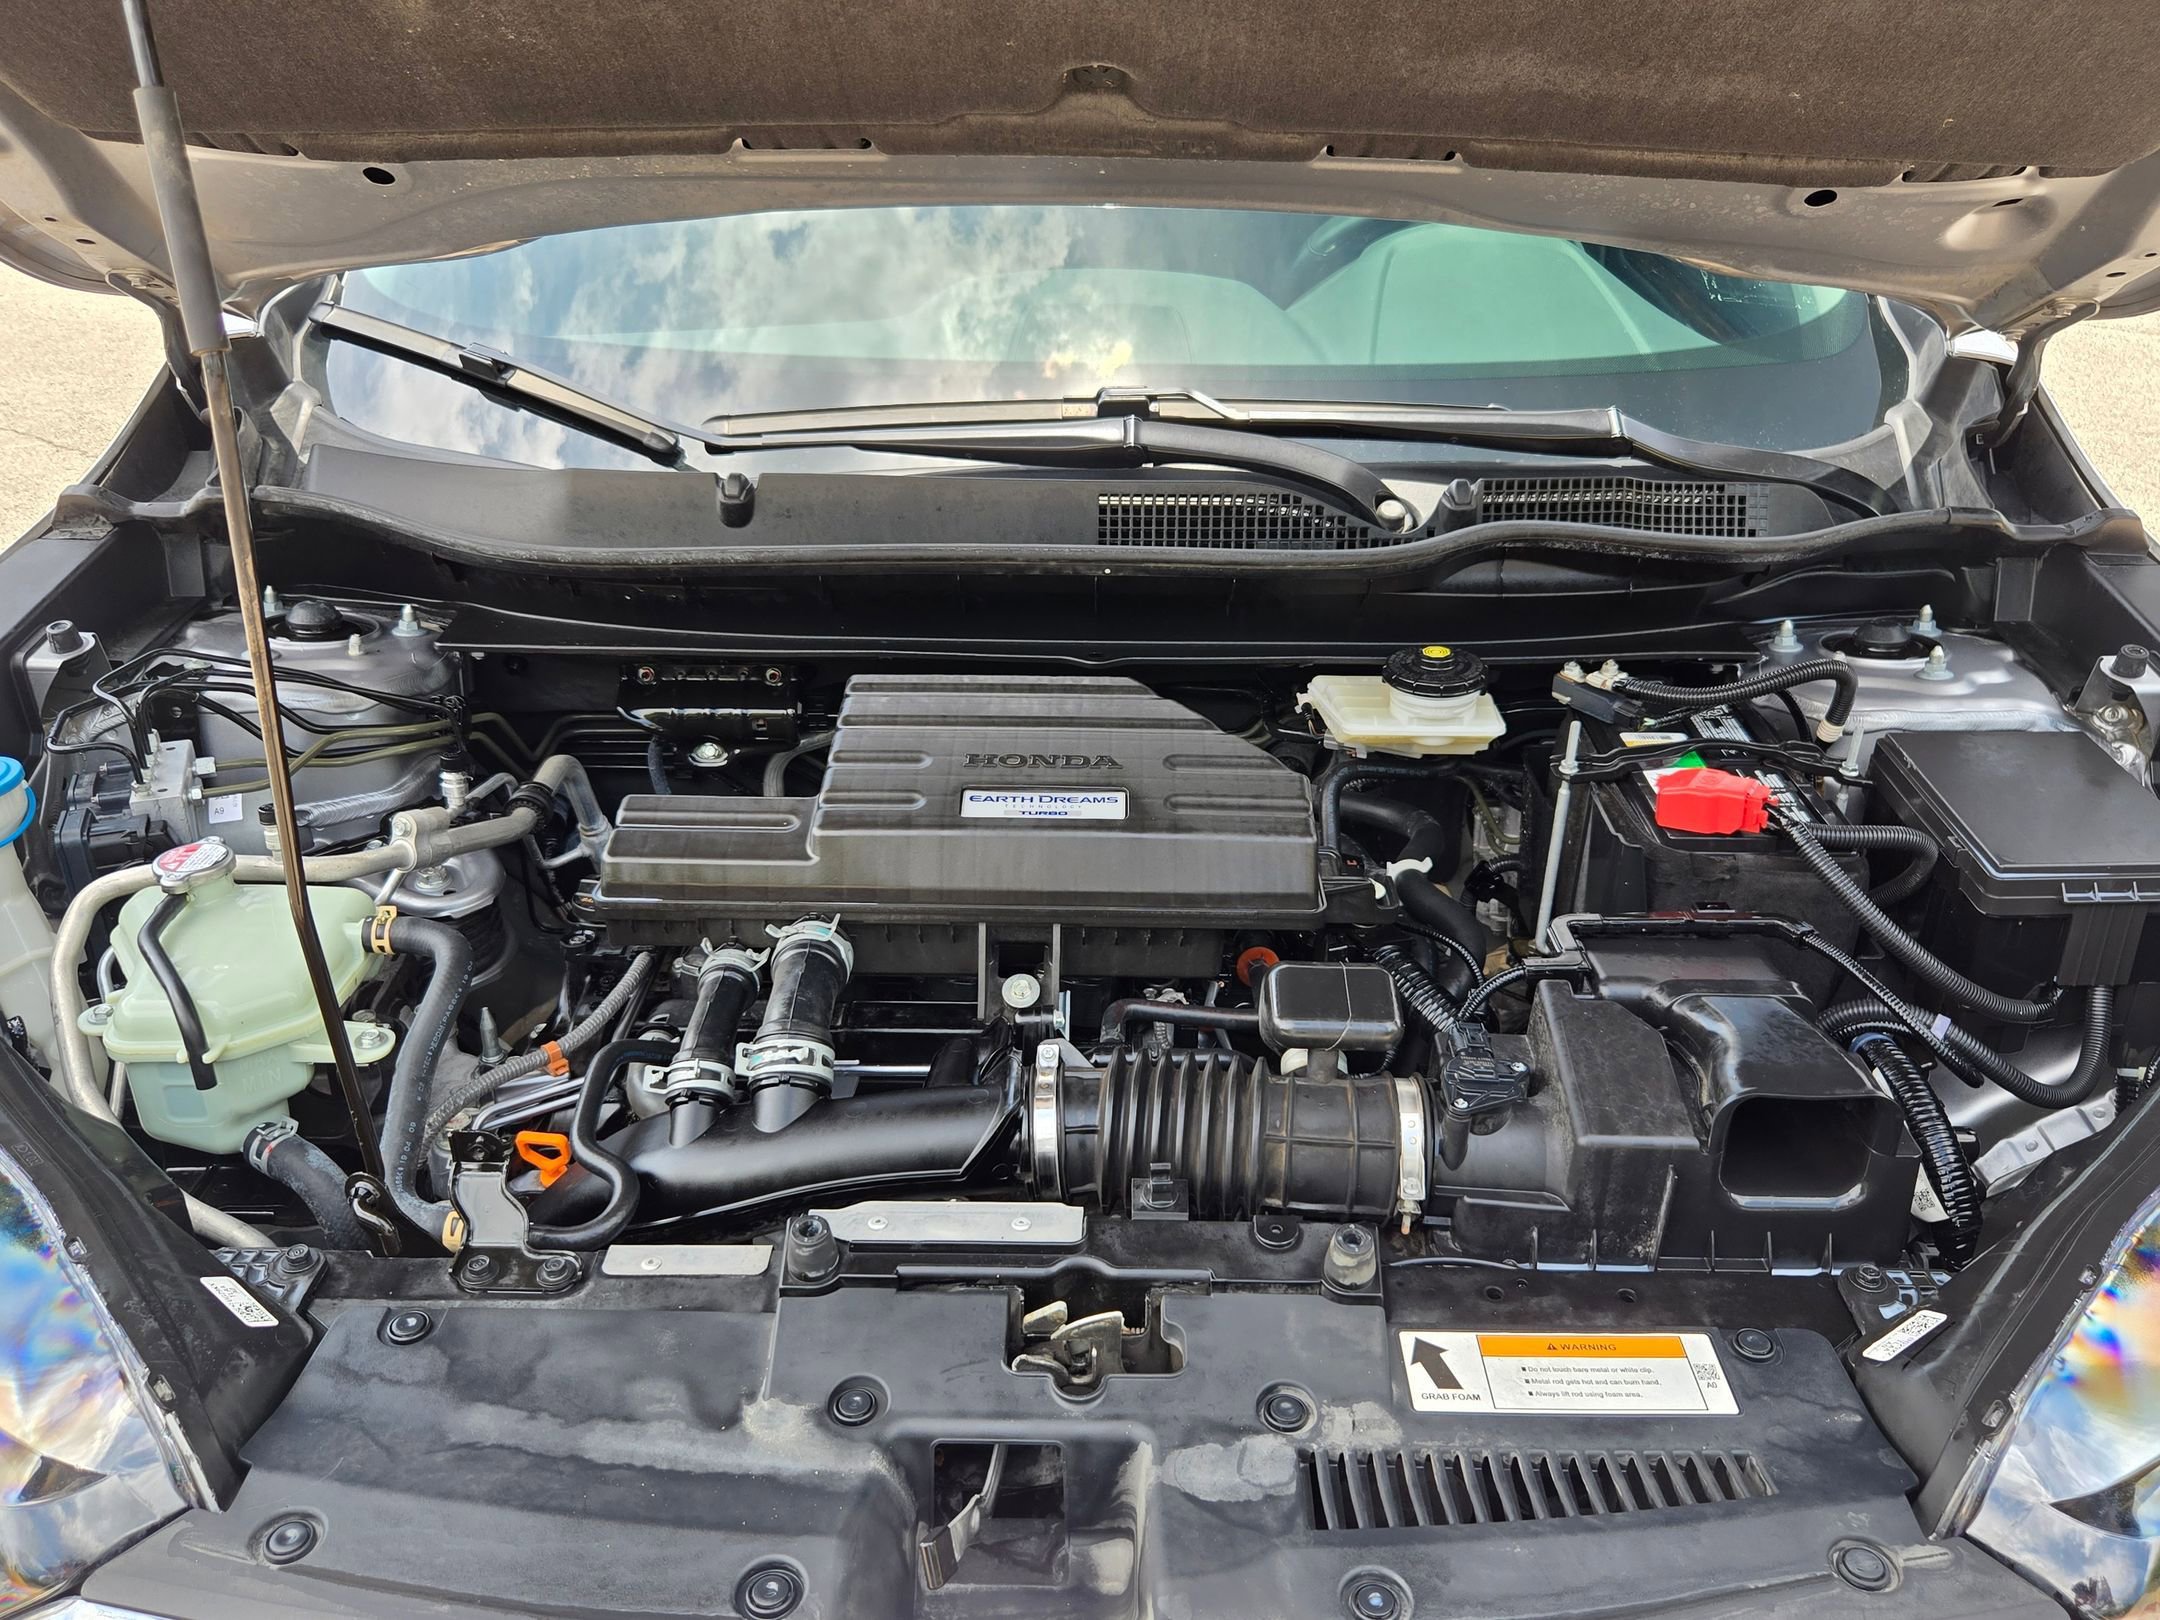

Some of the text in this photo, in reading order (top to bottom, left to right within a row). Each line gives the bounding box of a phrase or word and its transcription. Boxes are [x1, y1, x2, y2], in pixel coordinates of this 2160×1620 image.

[963, 753, 1124, 770] HONDA
[969, 795, 1119, 804] EARTH DREAMS
[1560, 1343, 1617, 1351] WARNING
[1421, 1392, 1481, 1401] GRAB FOAM
[1584, 1391, 1604, 1399] using
